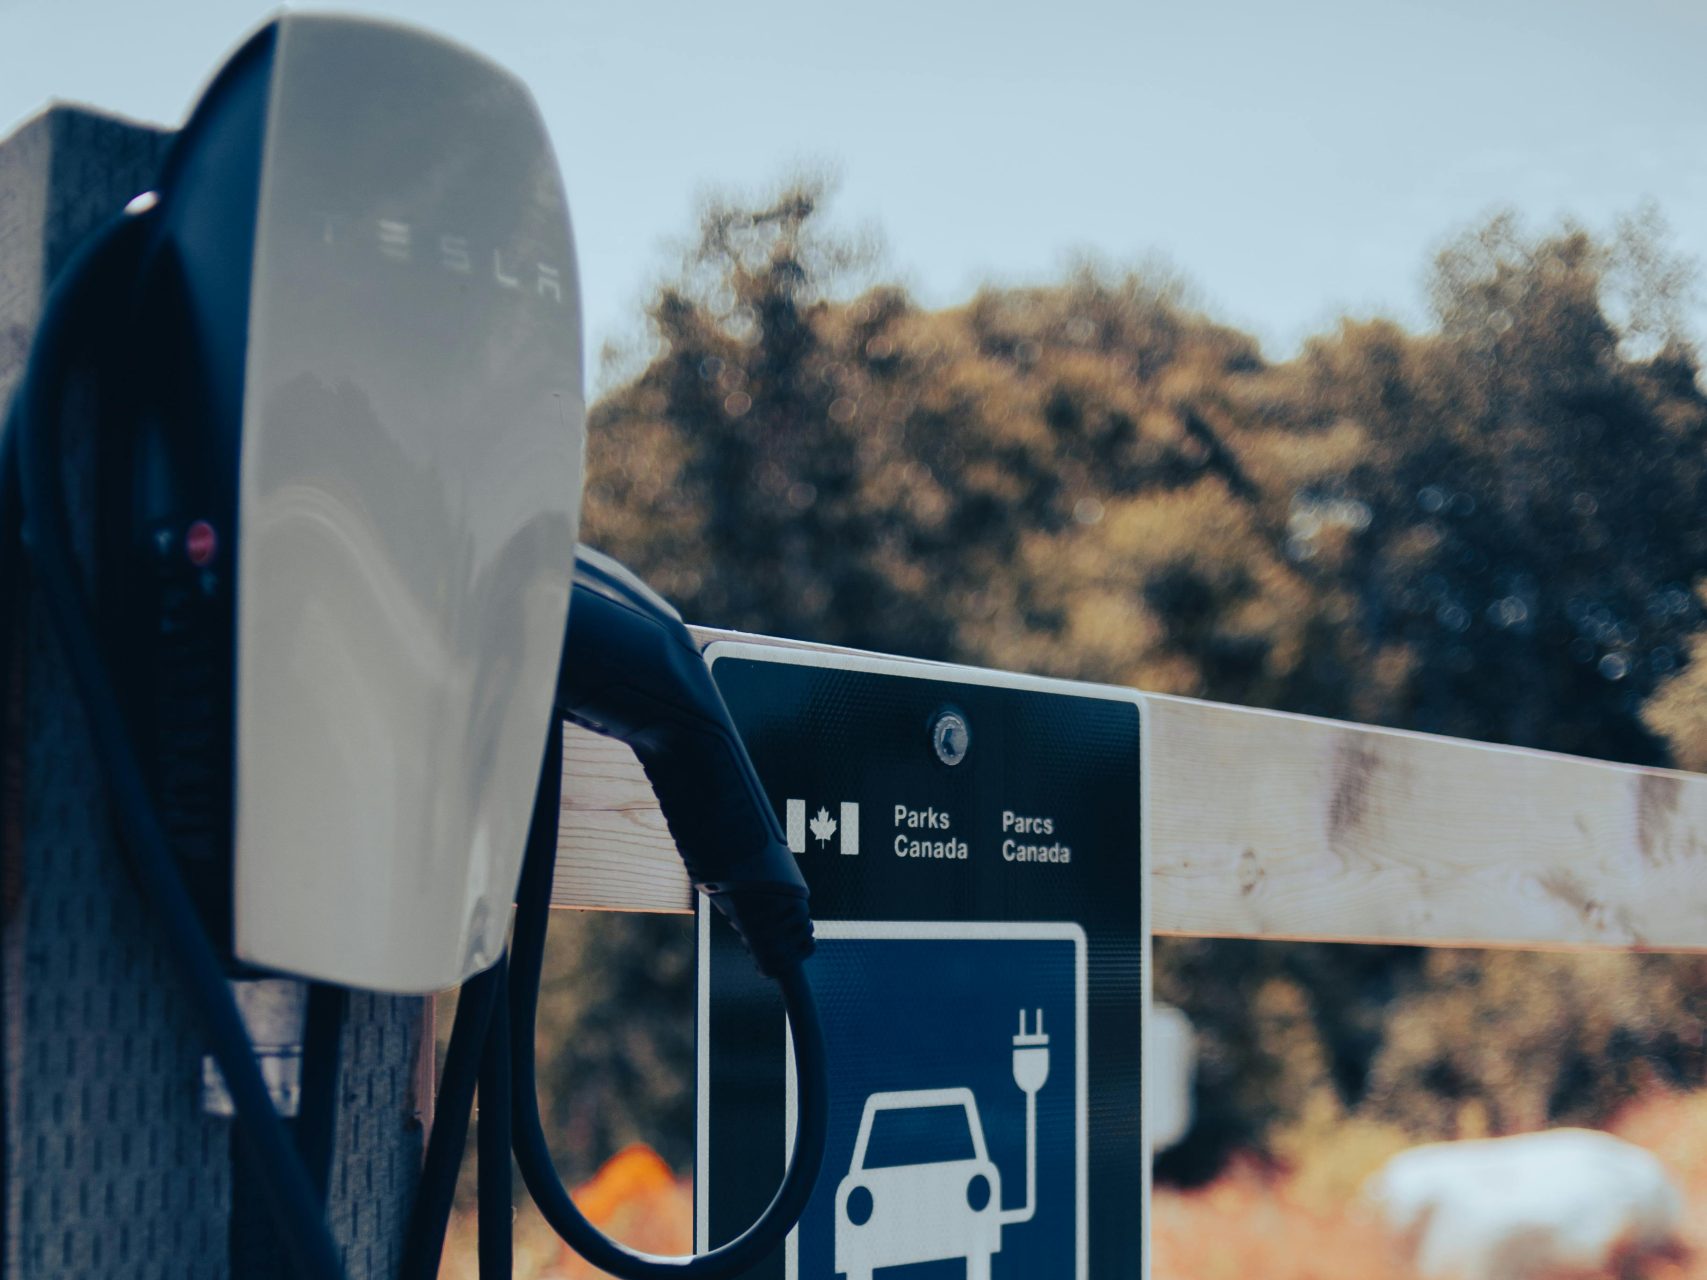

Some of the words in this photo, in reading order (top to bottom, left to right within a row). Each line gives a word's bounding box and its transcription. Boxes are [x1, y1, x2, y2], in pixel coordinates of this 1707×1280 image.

[312, 212, 562, 304] TESLA
[894, 804, 950, 830] Parks
[1002, 810, 1053, 835] Parcs
[894, 834, 968, 860] Canada
[1002, 839, 1070, 864] Canada
